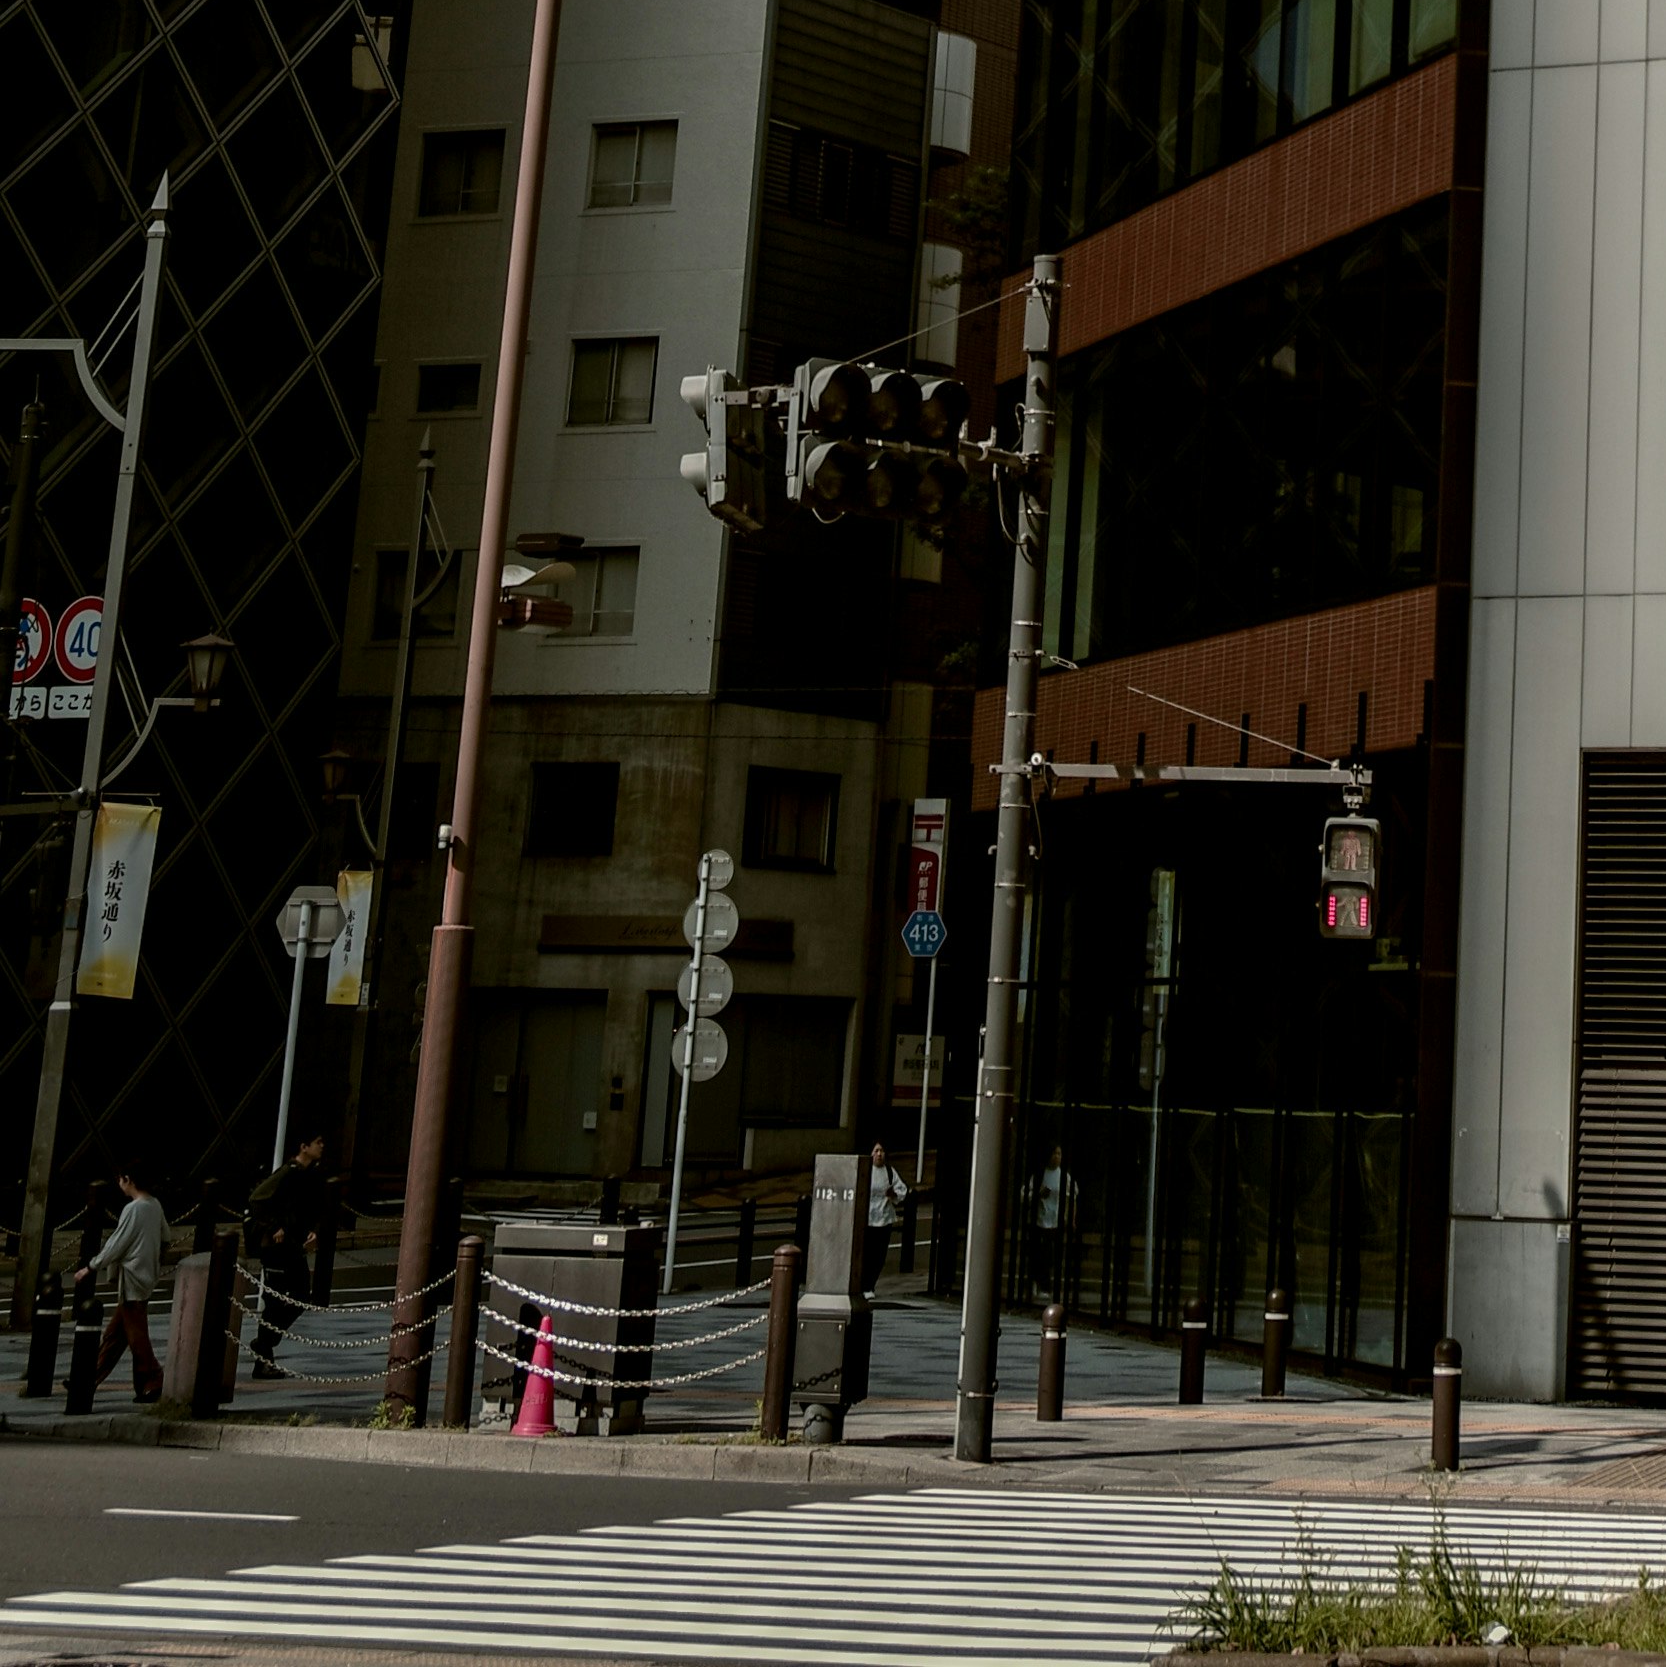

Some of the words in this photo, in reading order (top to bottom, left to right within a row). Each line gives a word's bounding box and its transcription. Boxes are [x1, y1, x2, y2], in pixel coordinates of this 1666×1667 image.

[69, 621, 102, 657] 40
[101, 860, 127, 943] 赤坂通り
[343, 909, 356, 967] 赤坂通り
[909, 923, 939, 942] 413
